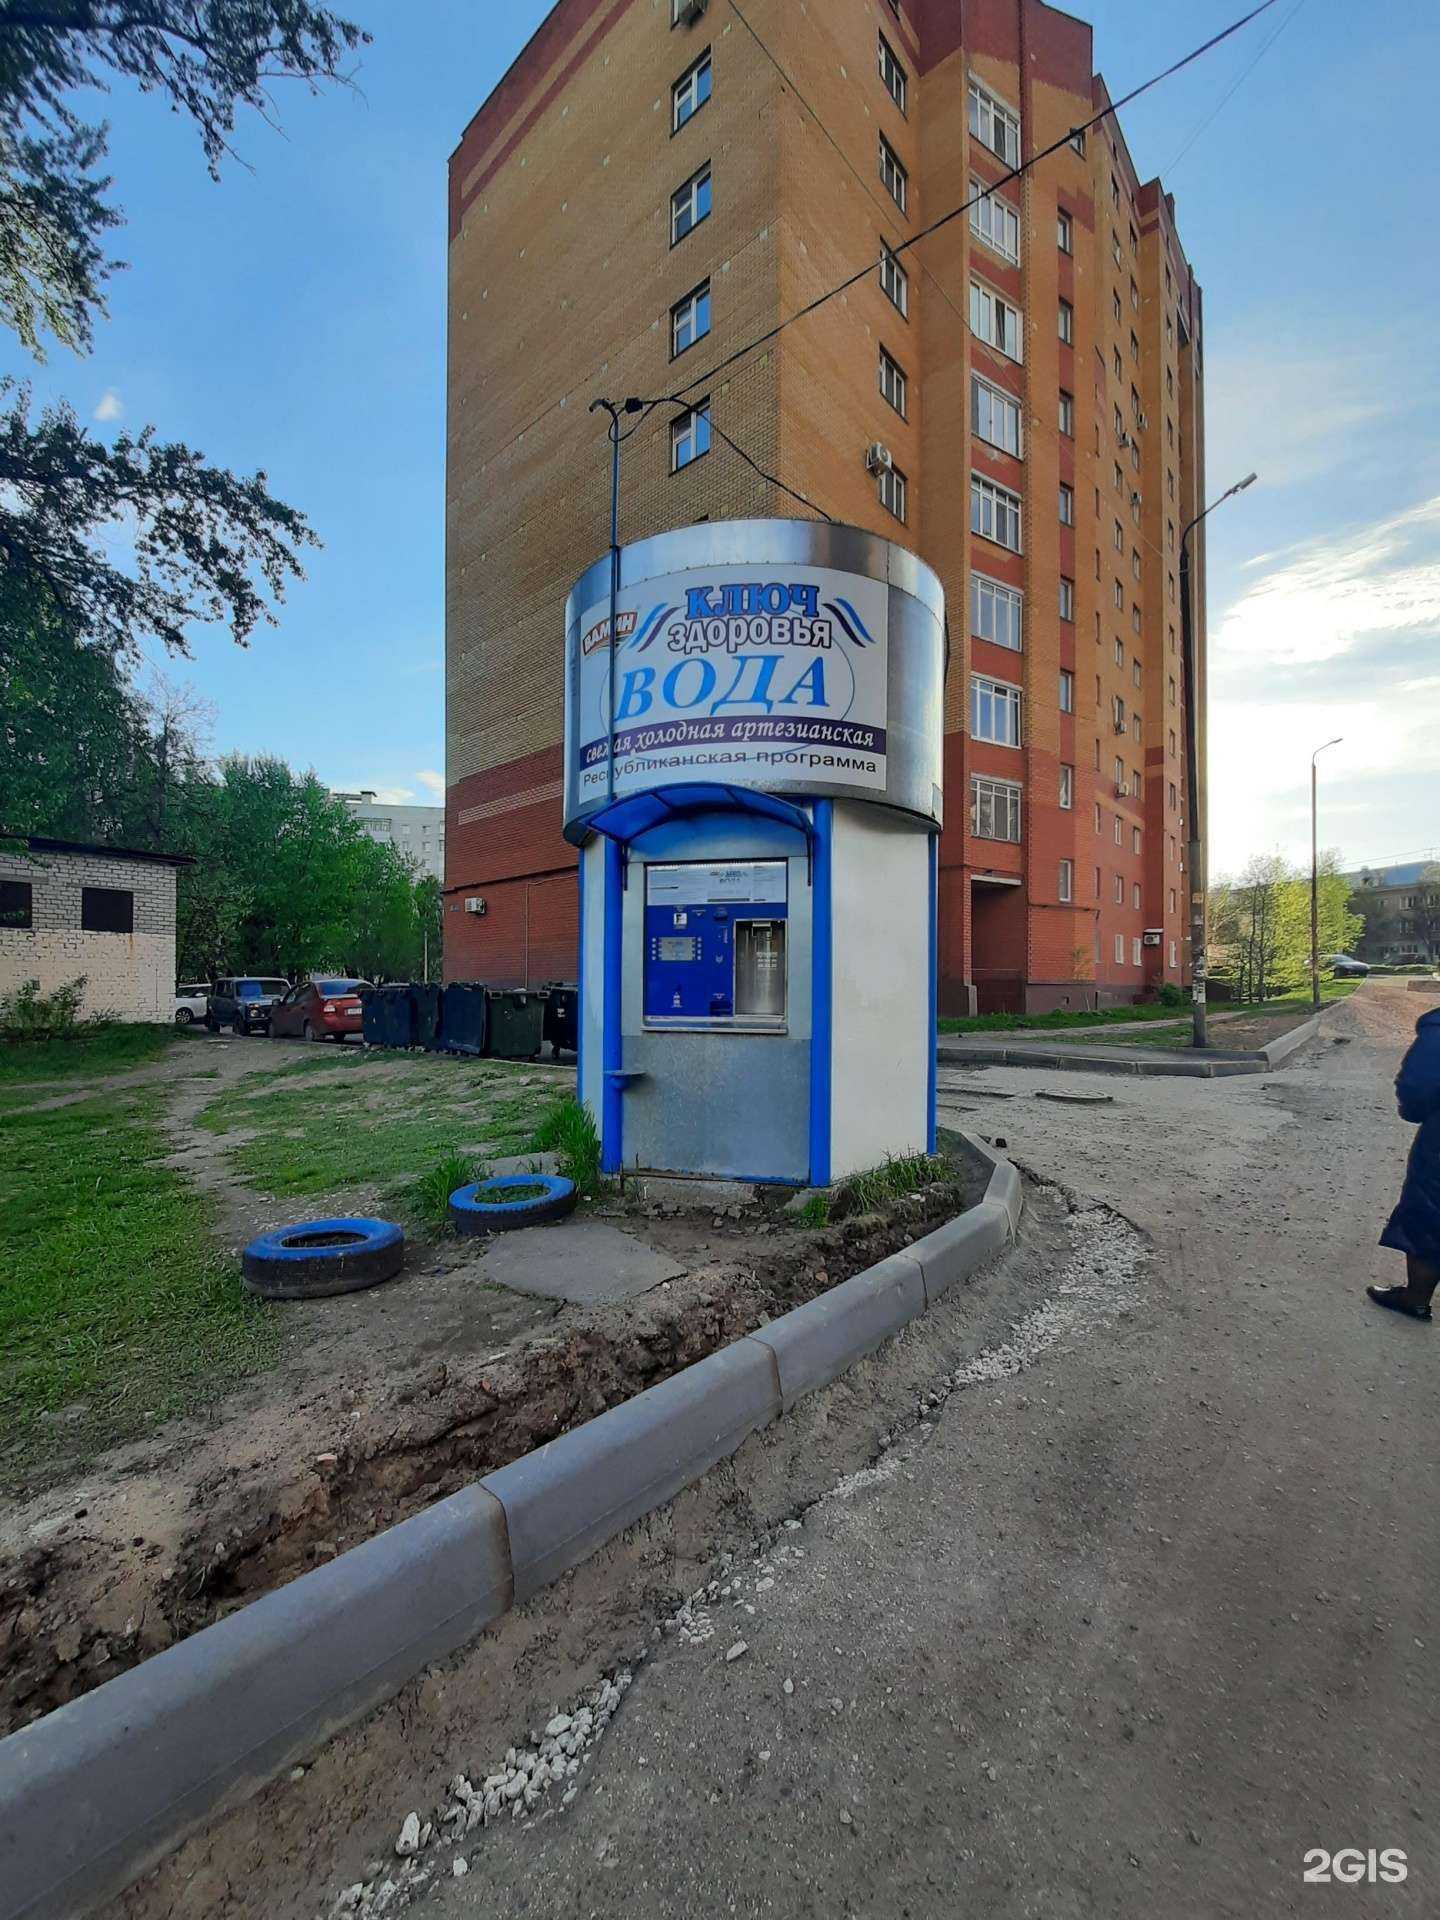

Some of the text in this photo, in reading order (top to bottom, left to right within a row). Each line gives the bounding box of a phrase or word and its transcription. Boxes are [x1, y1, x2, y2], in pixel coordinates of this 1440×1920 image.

[685, 582, 819, 621] КЛЮЧ
[613, 654, 830, 722] ВОДА
[634, 721, 726, 752] холодная
[731, 719, 875, 747] артезианская
[583, 750, 877, 788] Ресубликанская программа
